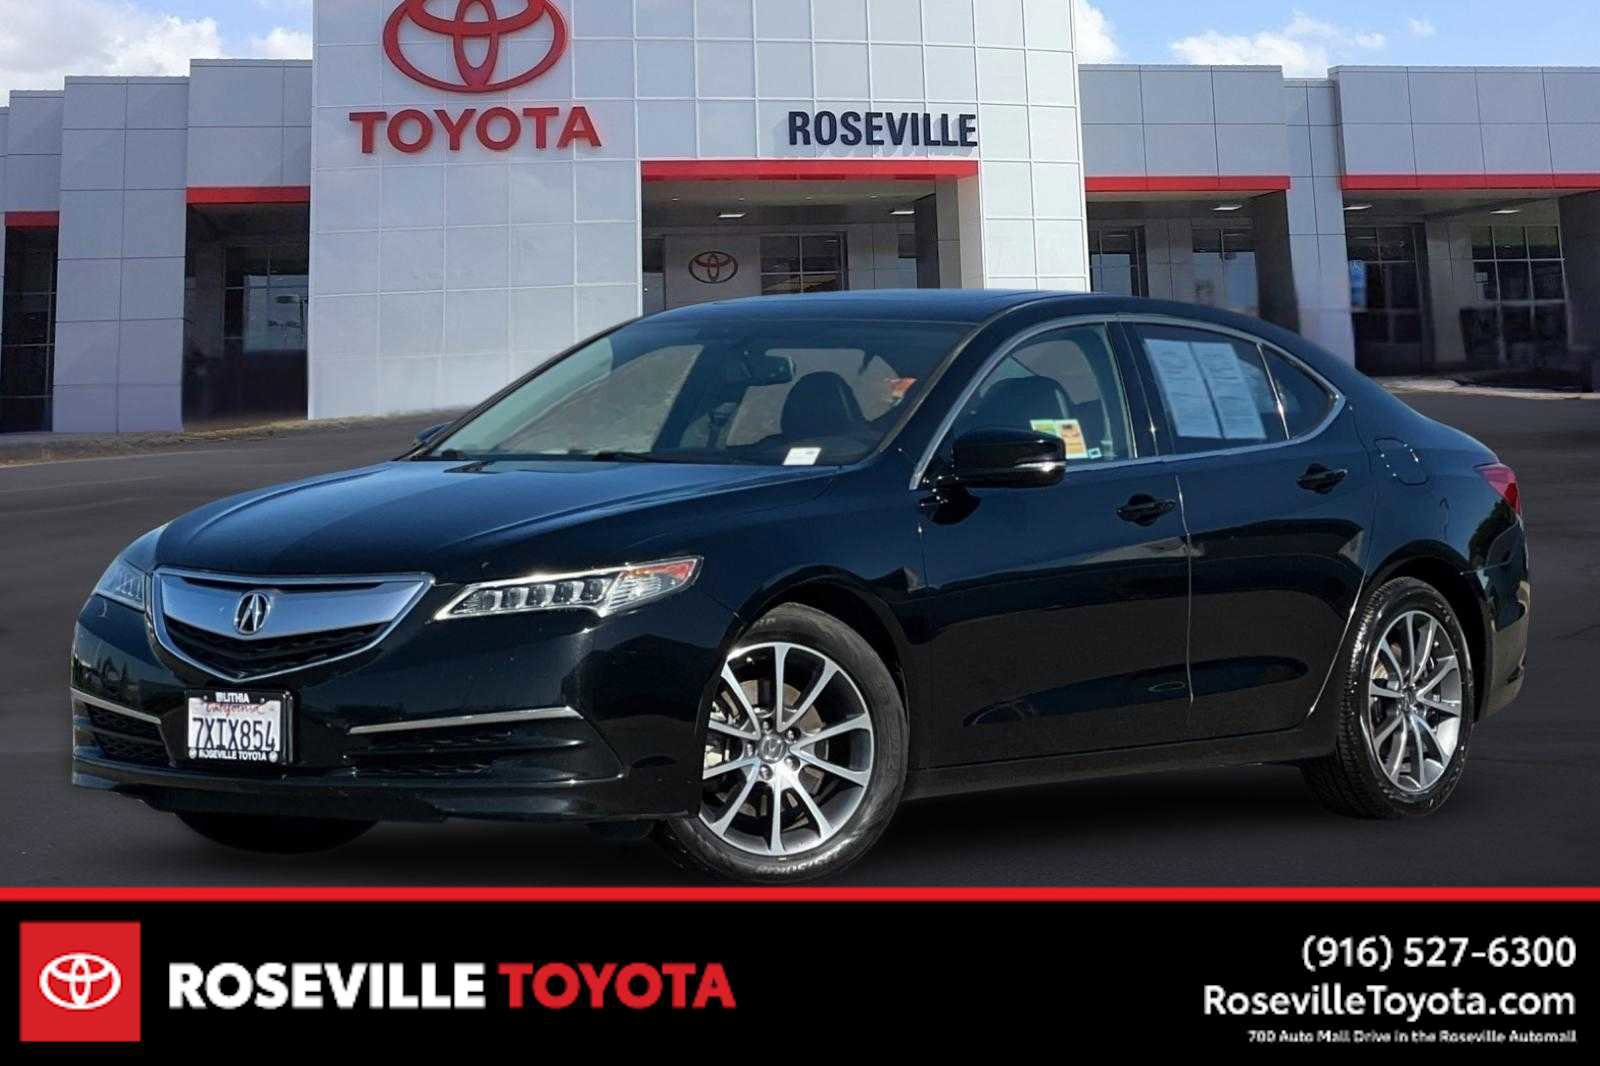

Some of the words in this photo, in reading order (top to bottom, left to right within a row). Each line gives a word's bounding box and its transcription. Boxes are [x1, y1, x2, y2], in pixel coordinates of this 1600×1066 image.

[349, 106, 602, 154] TOYOTA
[788, 111, 978, 147] ROSEVILLE
[192, 717, 276, 751] 7XIX854
[198, 749, 237, 760] ROSEVILLE
[238, 751, 267, 761] TOYOTA
